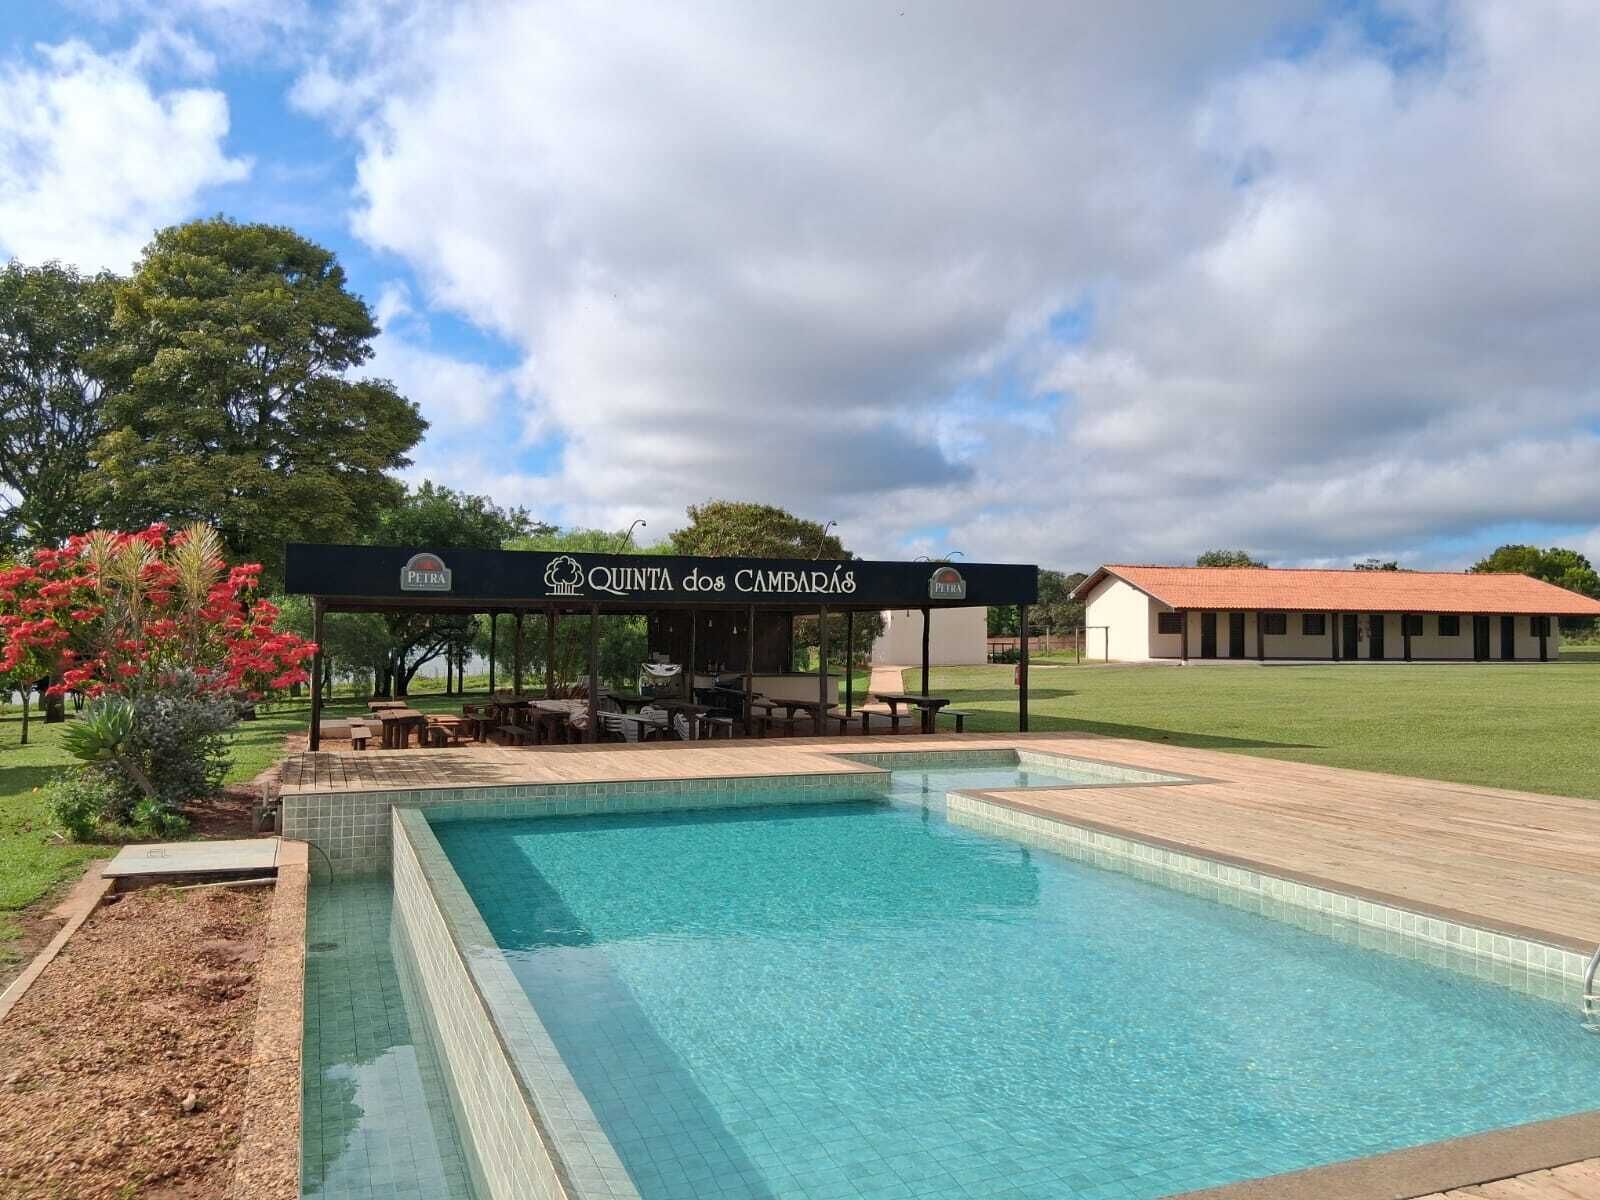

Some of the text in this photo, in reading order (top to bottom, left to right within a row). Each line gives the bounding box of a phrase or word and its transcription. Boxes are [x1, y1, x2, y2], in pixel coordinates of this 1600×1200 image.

[408, 571, 446, 584] PETRA
[588, 564, 857, 595] QUINTA dos CAMBARÁS
[935, 582, 962, 593] PETRA
